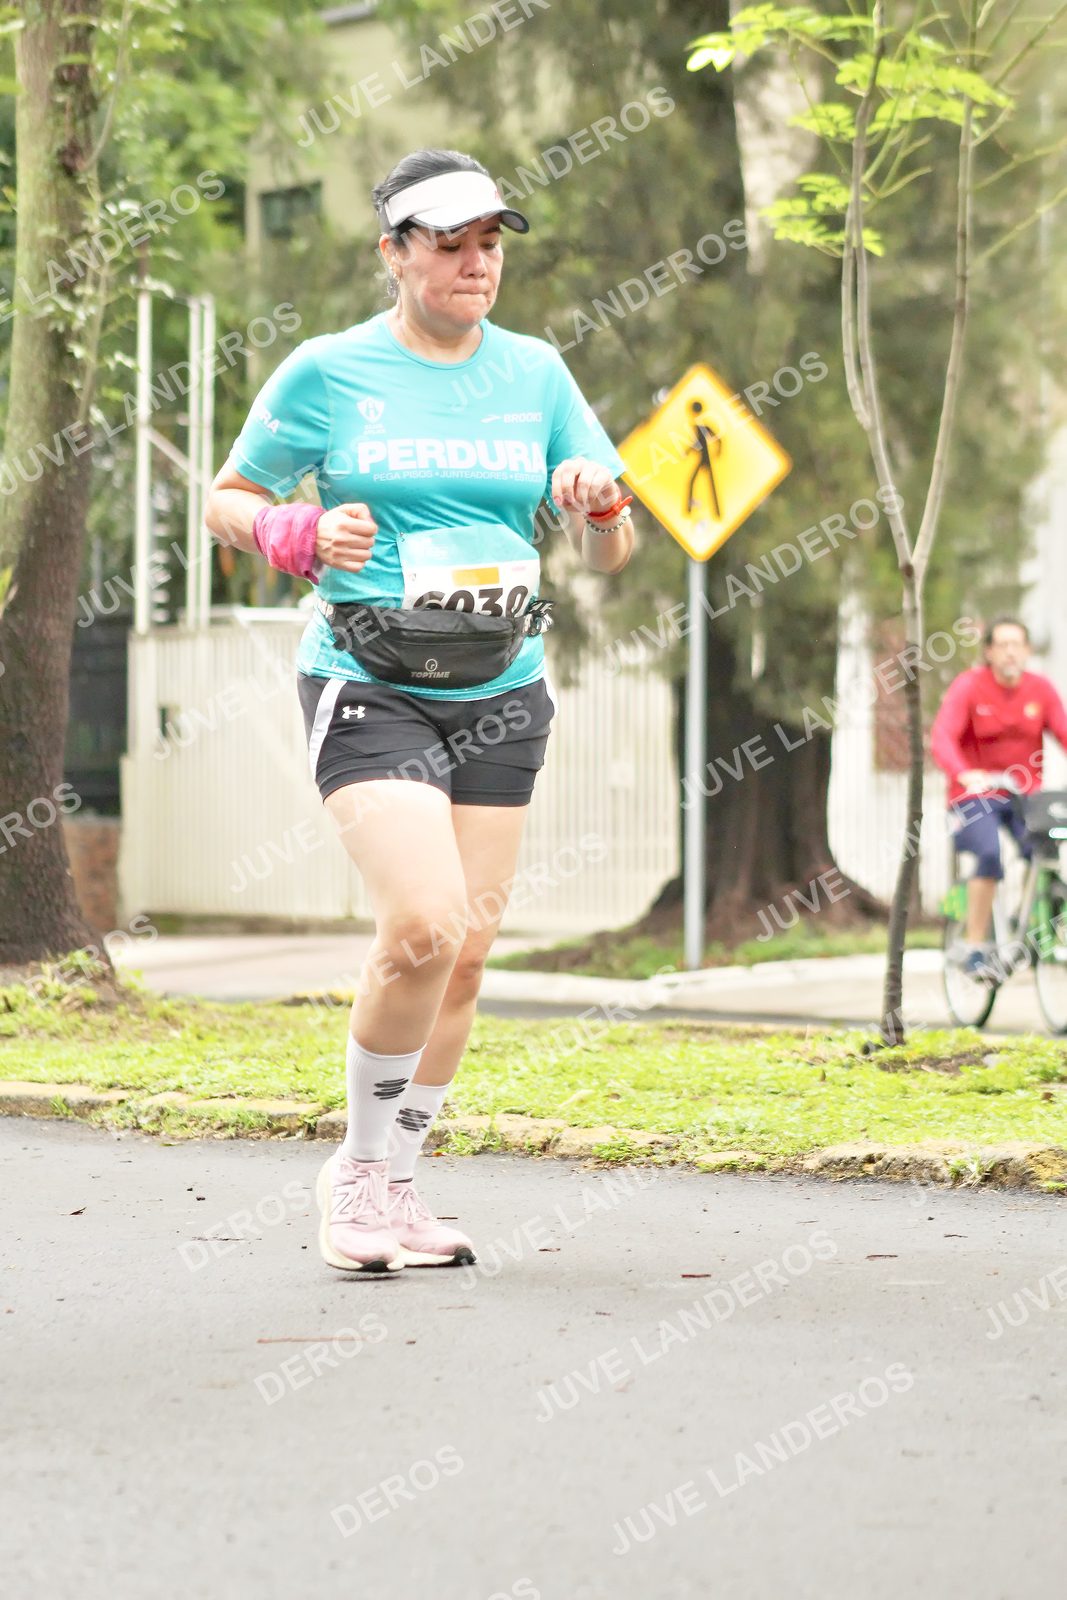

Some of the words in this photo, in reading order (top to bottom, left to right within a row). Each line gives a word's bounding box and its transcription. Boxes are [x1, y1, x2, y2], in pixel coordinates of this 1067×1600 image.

[358, 438, 545, 474] PERDURA
[373, 472, 400, 481] PEGA
[403, 469, 433, 479] PISOS
[440, 471, 508, 480] JUNTEADORES
[411, 671, 450, 679] TOPTIME
